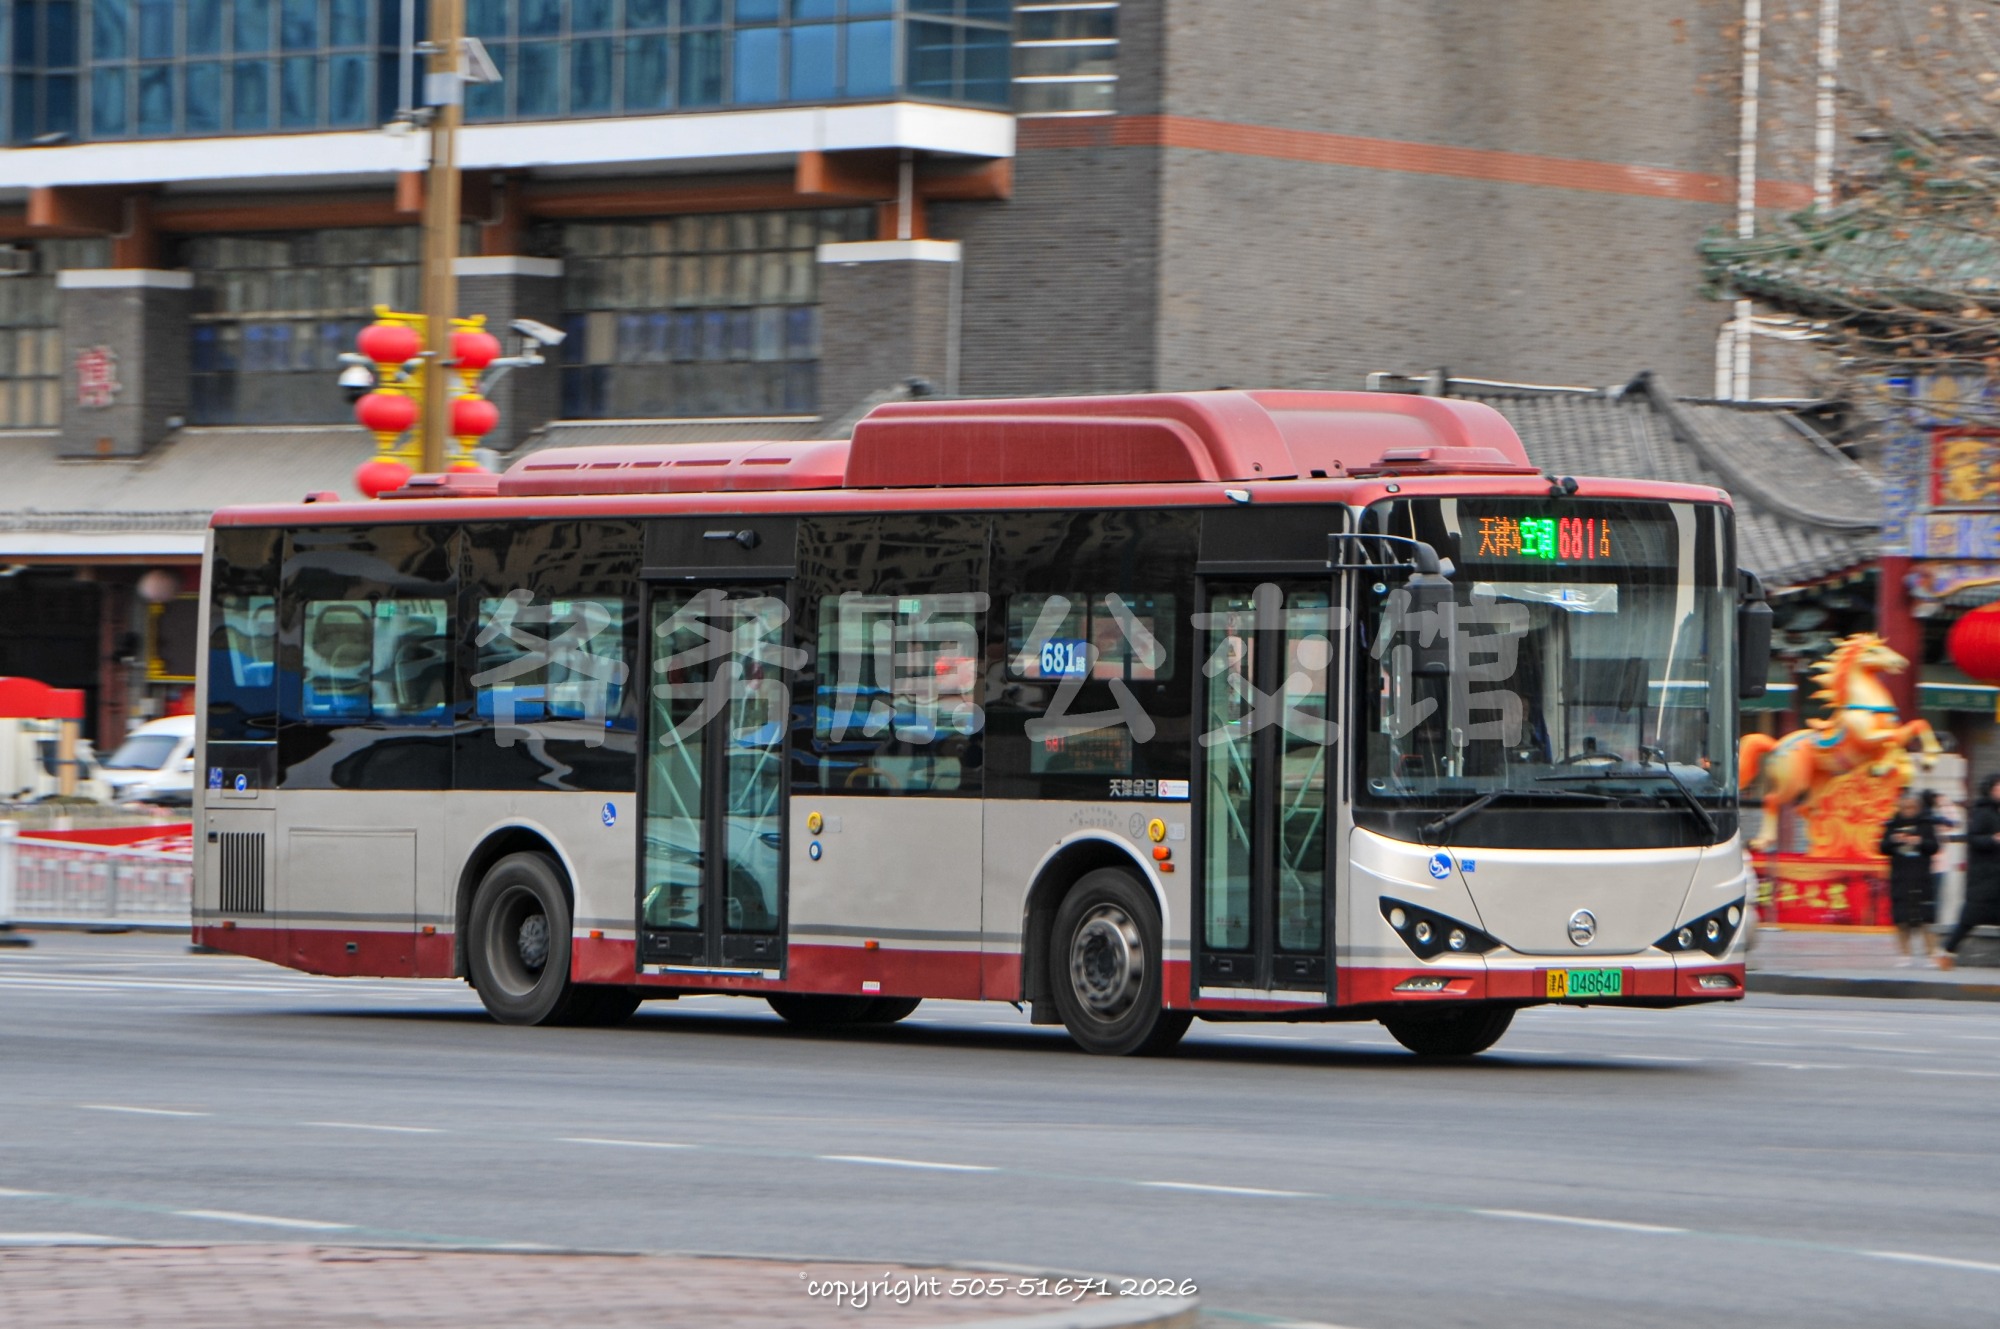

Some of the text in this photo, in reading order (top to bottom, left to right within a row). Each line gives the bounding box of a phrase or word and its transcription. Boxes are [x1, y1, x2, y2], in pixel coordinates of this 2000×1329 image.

[1559, 517, 1595, 560] 681
[1109, 779, 1157, 797] 天津金马
